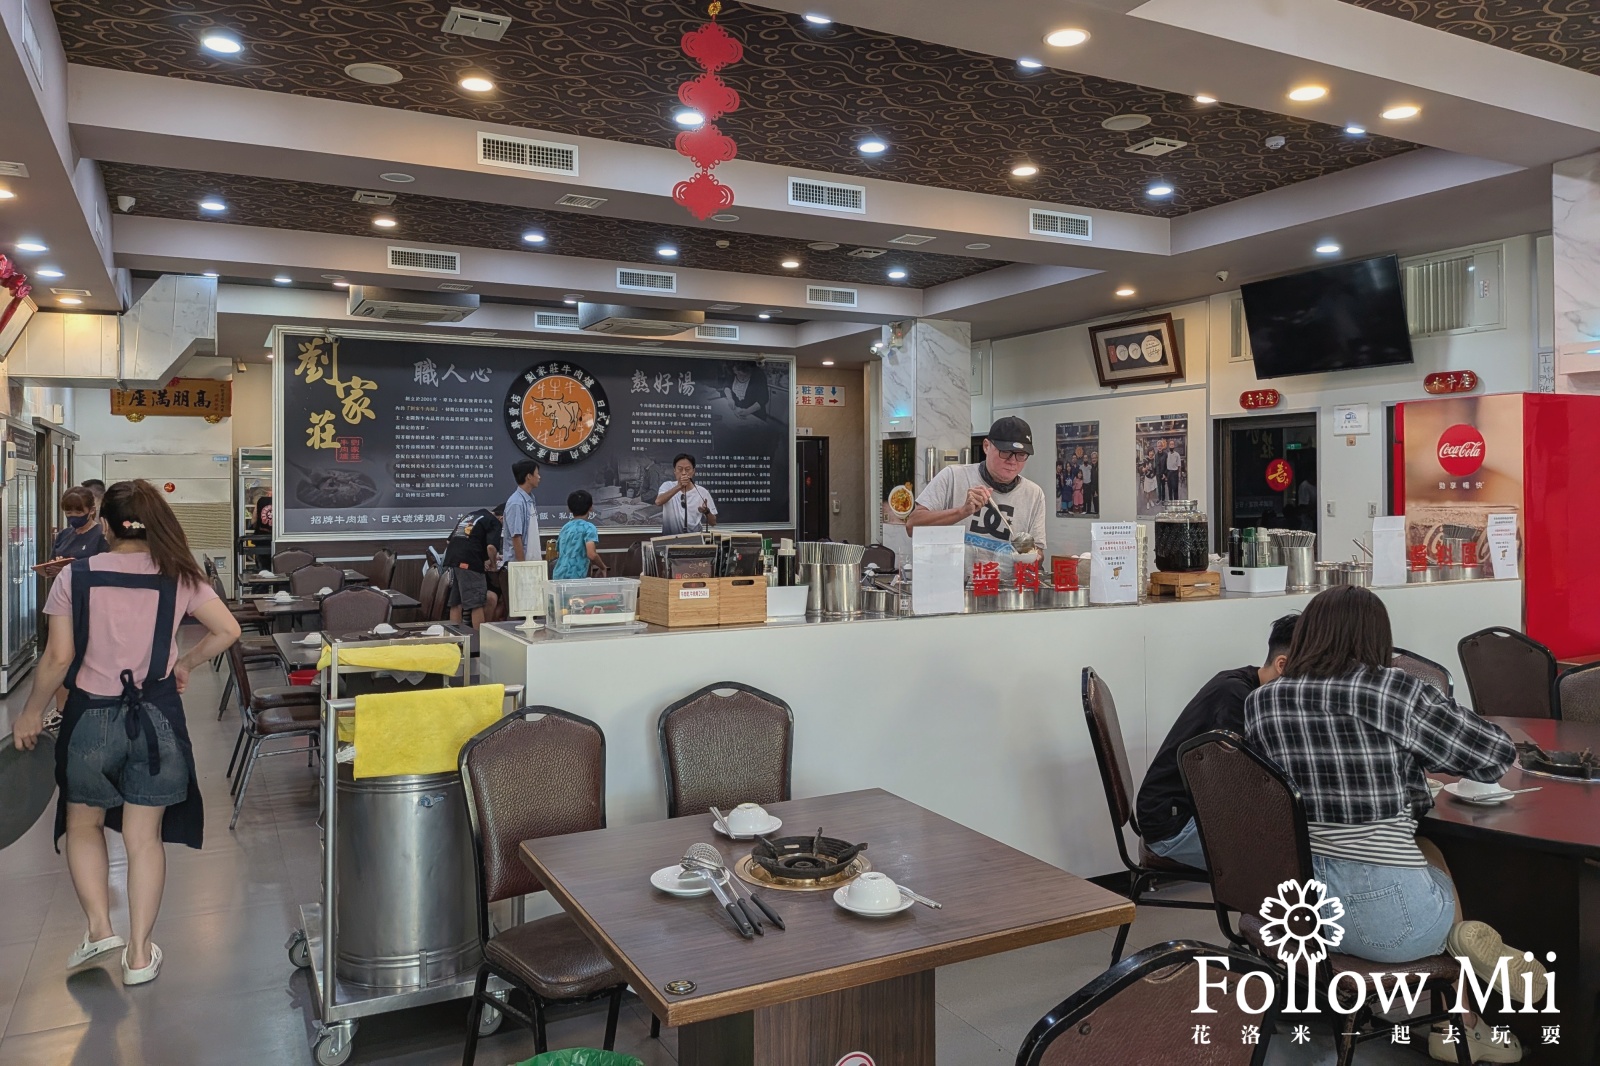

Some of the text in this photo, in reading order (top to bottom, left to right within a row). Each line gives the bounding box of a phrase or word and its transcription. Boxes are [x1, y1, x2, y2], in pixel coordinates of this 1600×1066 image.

[413, 357, 493, 387] 職人心
[630, 369, 696, 397] 熬好湯
[1439, 441, 1483, 459] Coca-Cola
[1409, 542, 1478, 573] 醬料區
[972, 559, 1079, 597] 醬料區
